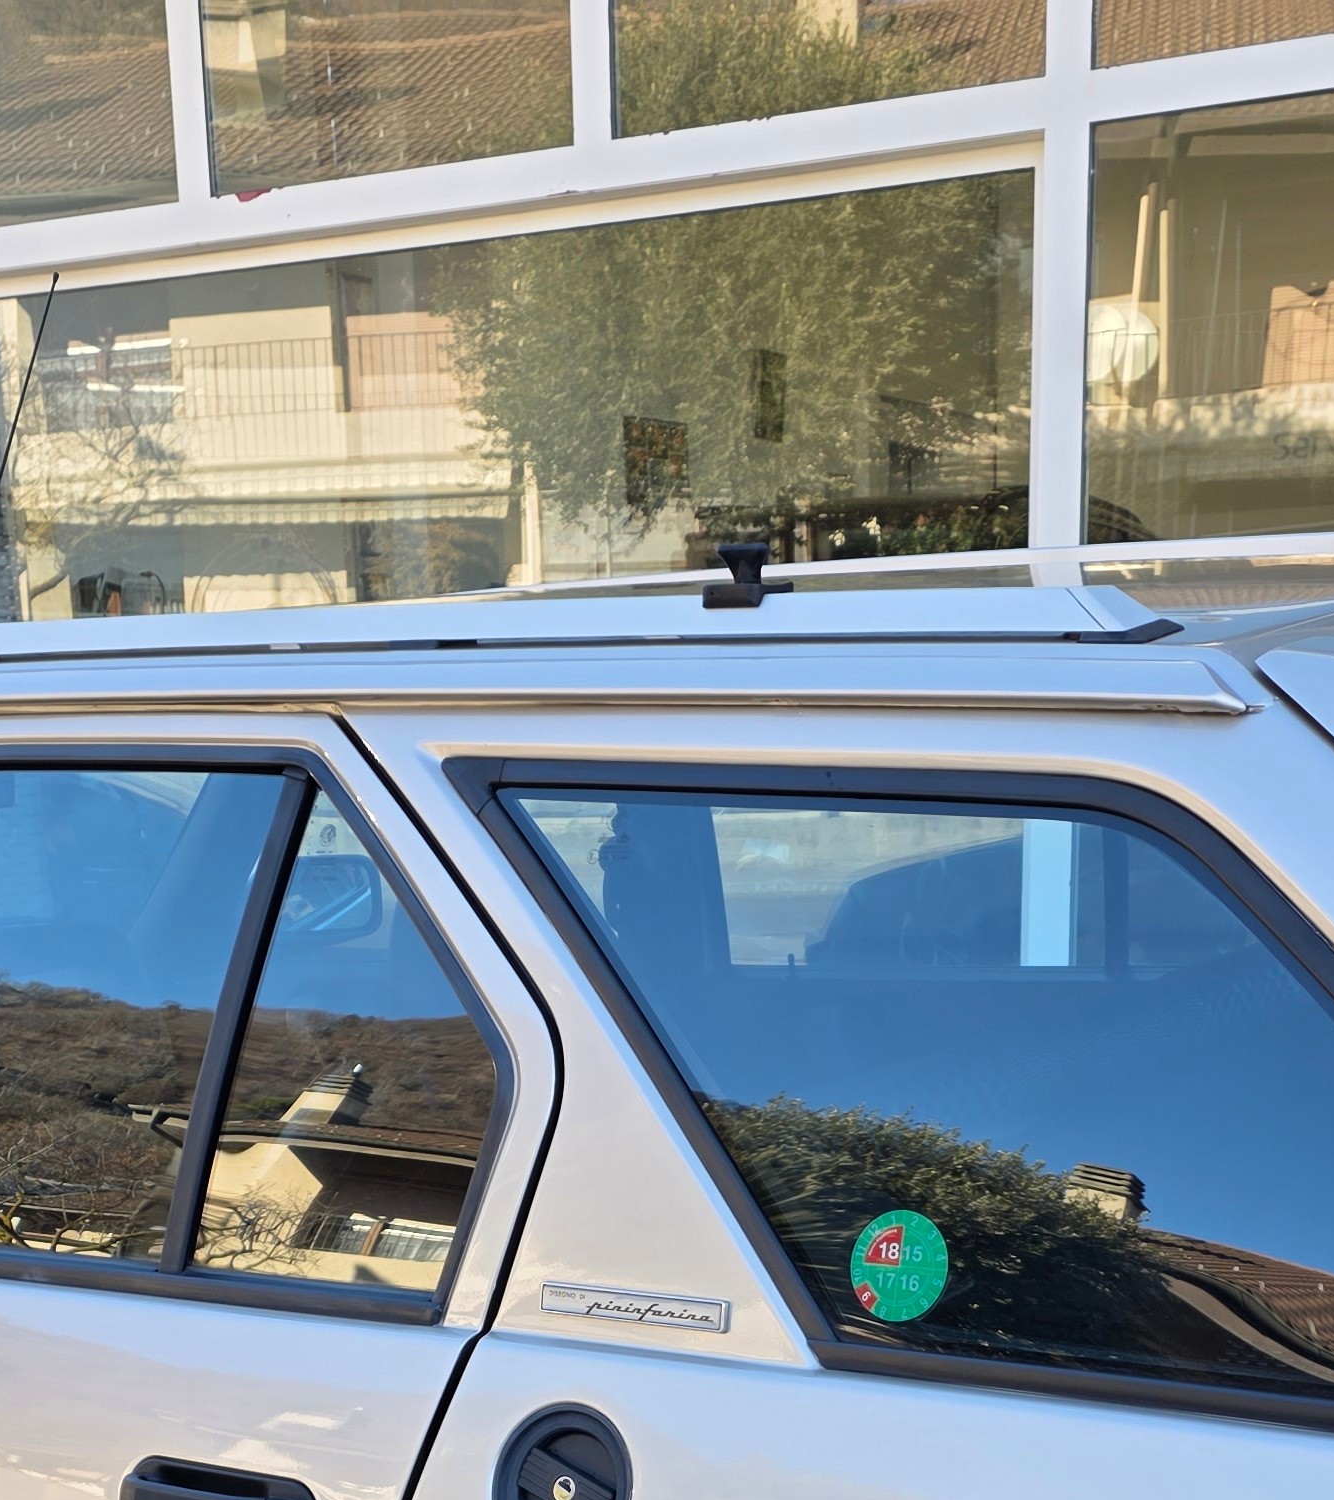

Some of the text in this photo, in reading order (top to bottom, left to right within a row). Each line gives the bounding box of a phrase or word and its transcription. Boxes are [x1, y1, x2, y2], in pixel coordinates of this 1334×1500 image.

[910, 1216, 919, 1227] 2
[928, 1231, 937, 1241] 3
[879, 1241, 923, 1262] 18 15
[876, 1271, 920, 1291] 17 16
[586, 1300, 714, 1322] pininfarina
